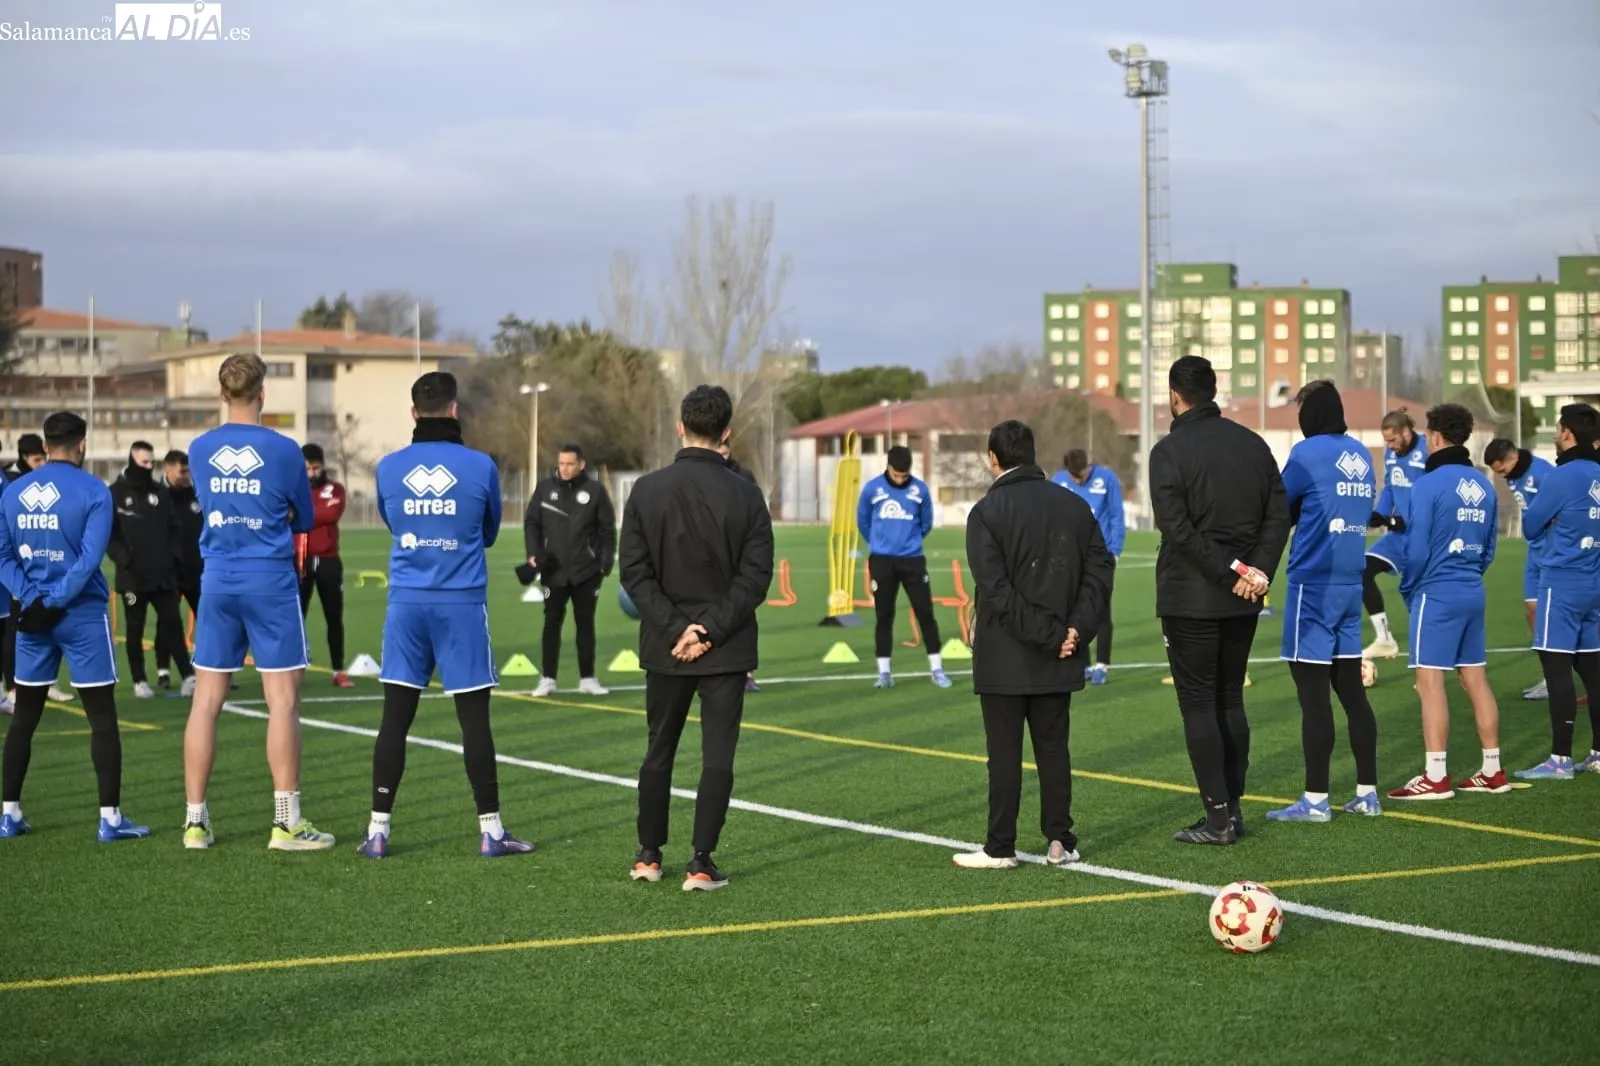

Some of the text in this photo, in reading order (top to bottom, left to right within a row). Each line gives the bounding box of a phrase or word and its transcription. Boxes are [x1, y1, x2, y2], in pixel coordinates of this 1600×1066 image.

[210, 476, 261, 496] errea
[1336, 481, 1372, 498] errea
[403, 498, 457, 516] errea
[1457, 507, 1486, 524] errea
[17, 513, 59, 530] errea
